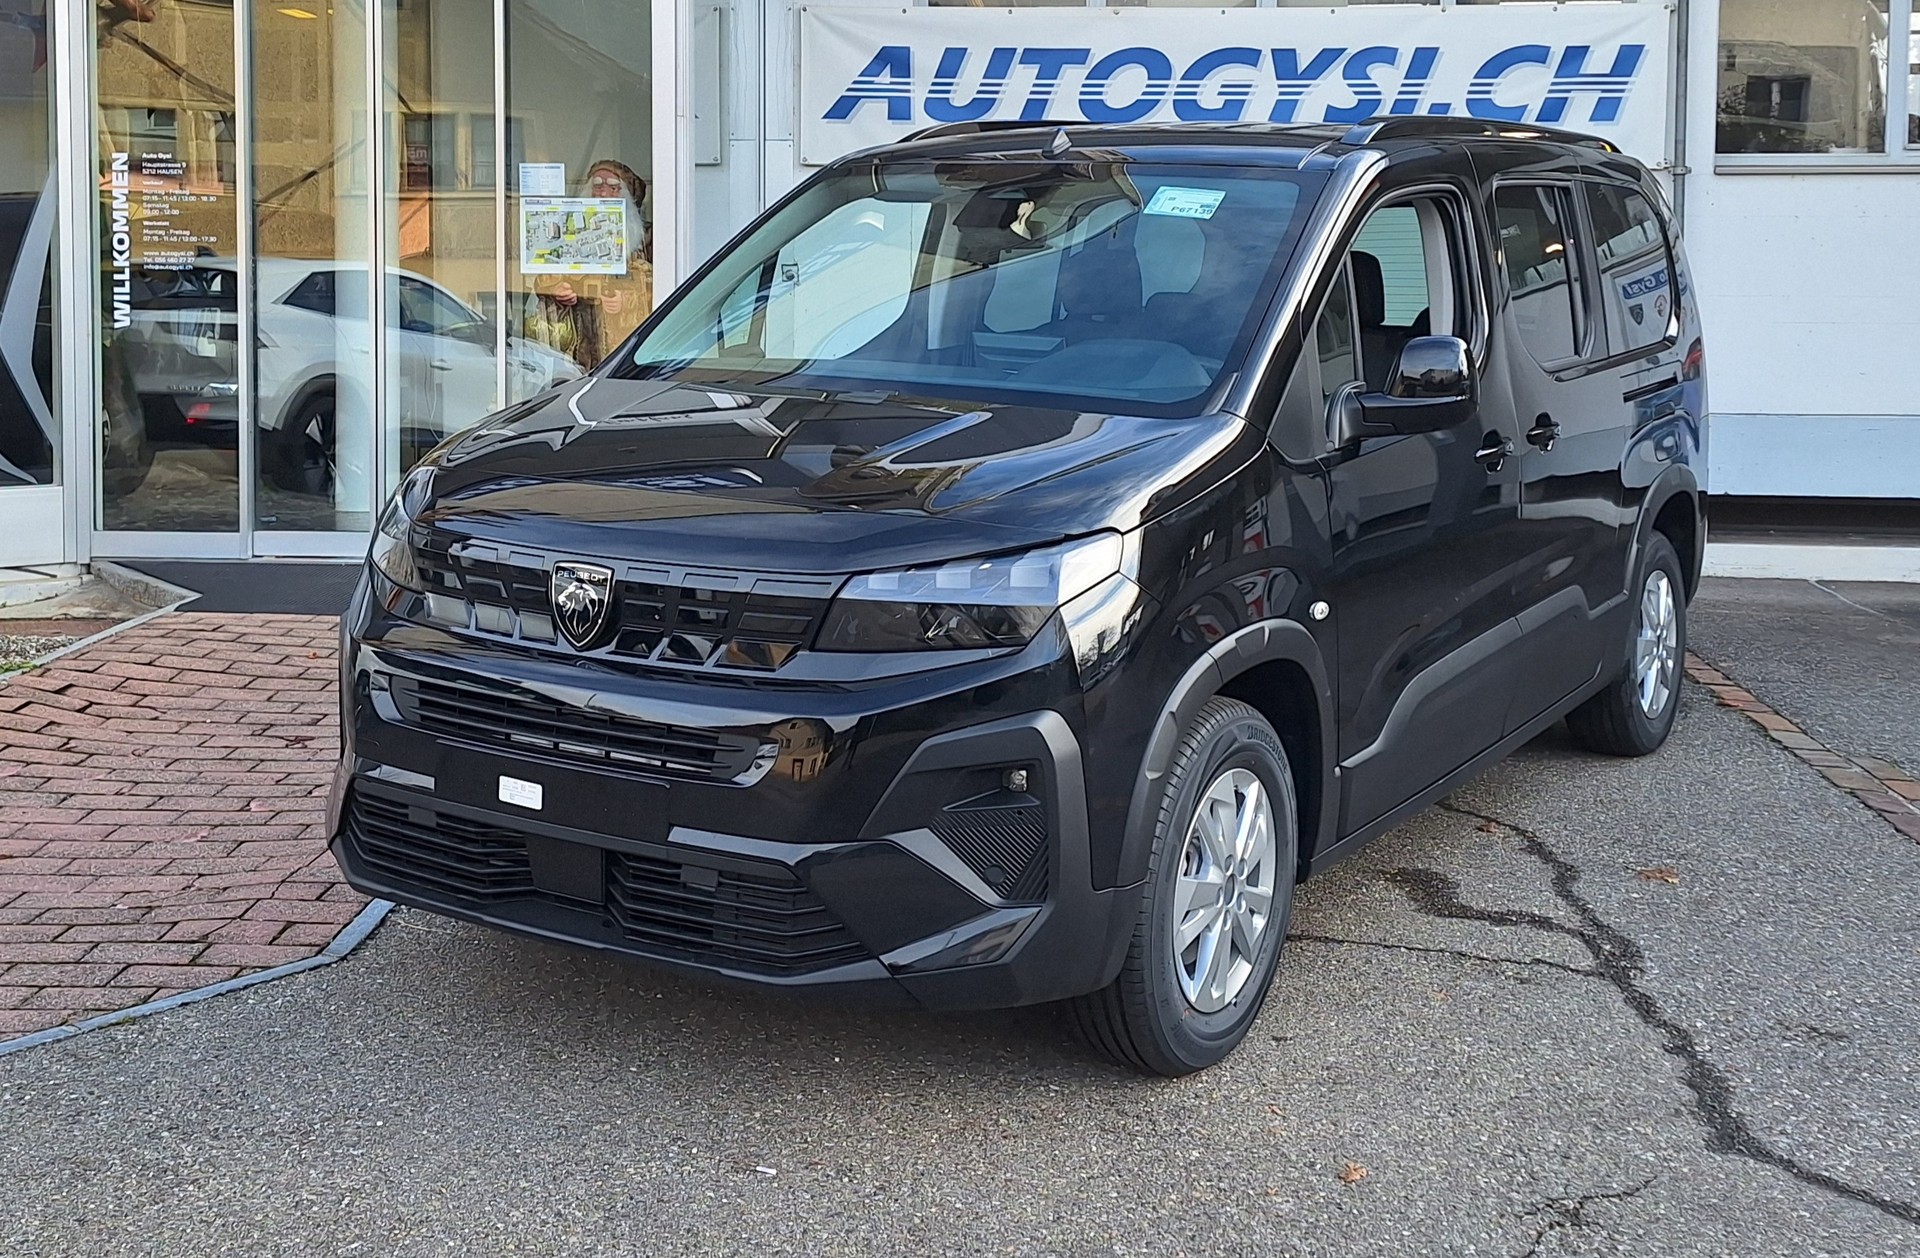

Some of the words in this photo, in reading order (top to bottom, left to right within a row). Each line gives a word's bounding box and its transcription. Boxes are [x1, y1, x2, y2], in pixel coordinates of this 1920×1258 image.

[820, 44, 1646, 122] AUTOGYSI.CH
[1171, 206, 1213, 216] P67139
[112, 152, 131, 329] WILLKOMMEN
[557, 570, 606, 582] PEUGEOT
[1246, 724, 1289, 775] BRIDGESTONE
